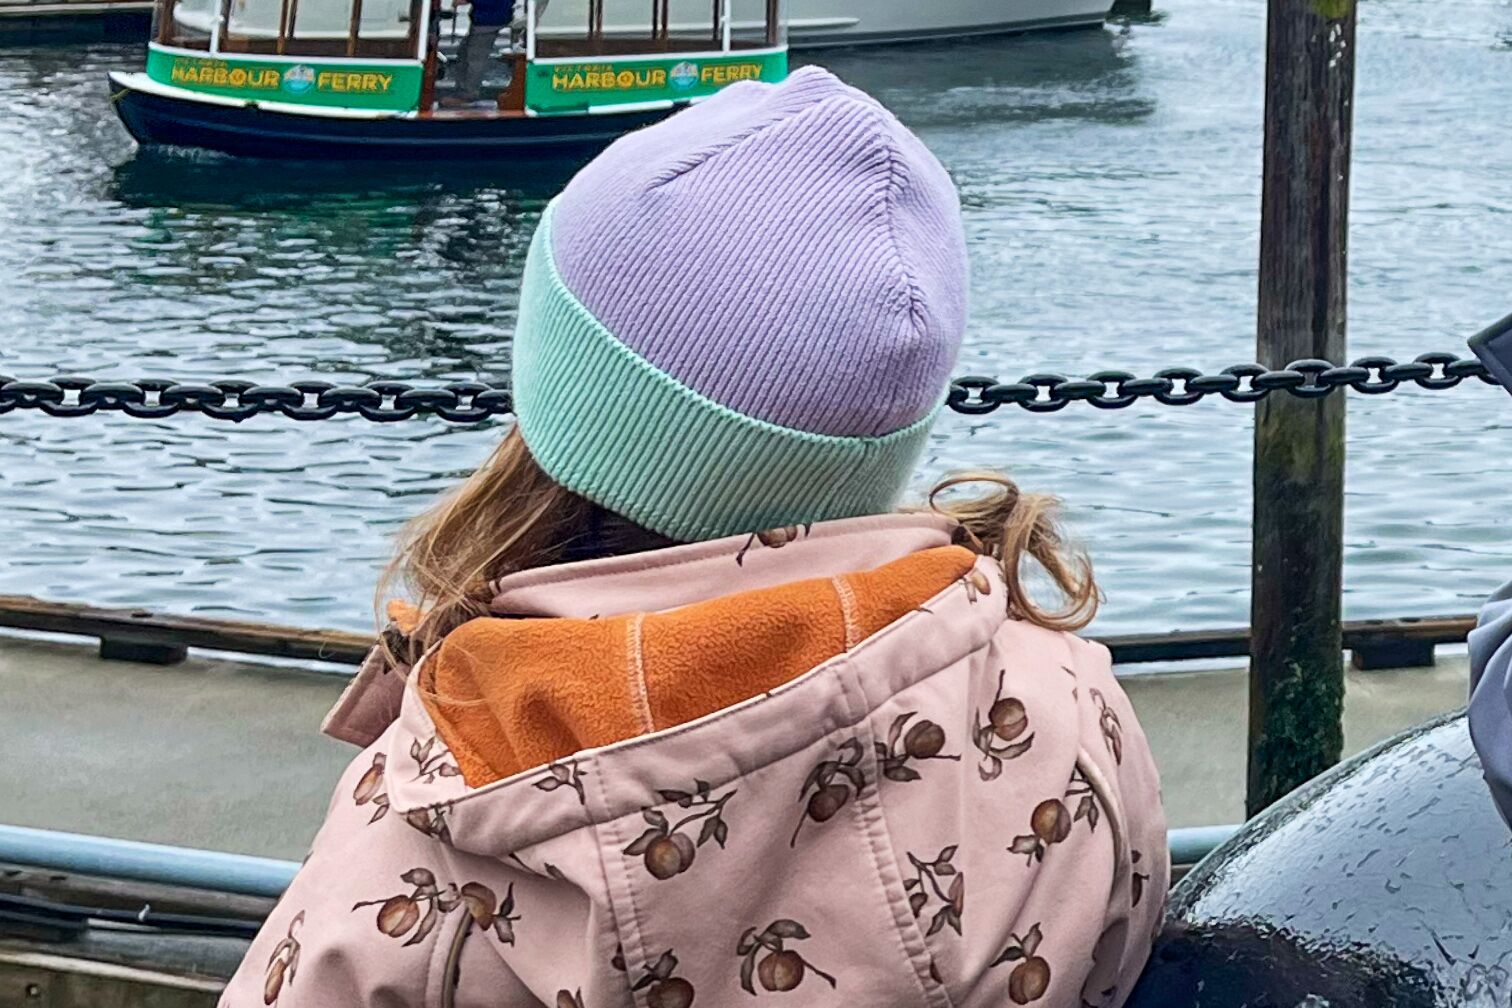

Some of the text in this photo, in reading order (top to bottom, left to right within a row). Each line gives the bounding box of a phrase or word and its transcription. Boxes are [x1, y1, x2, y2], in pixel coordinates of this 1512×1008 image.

[172, 66, 391, 90] HARBOUR FERRY
[553, 64, 763, 89] HARBOUR FERRY
